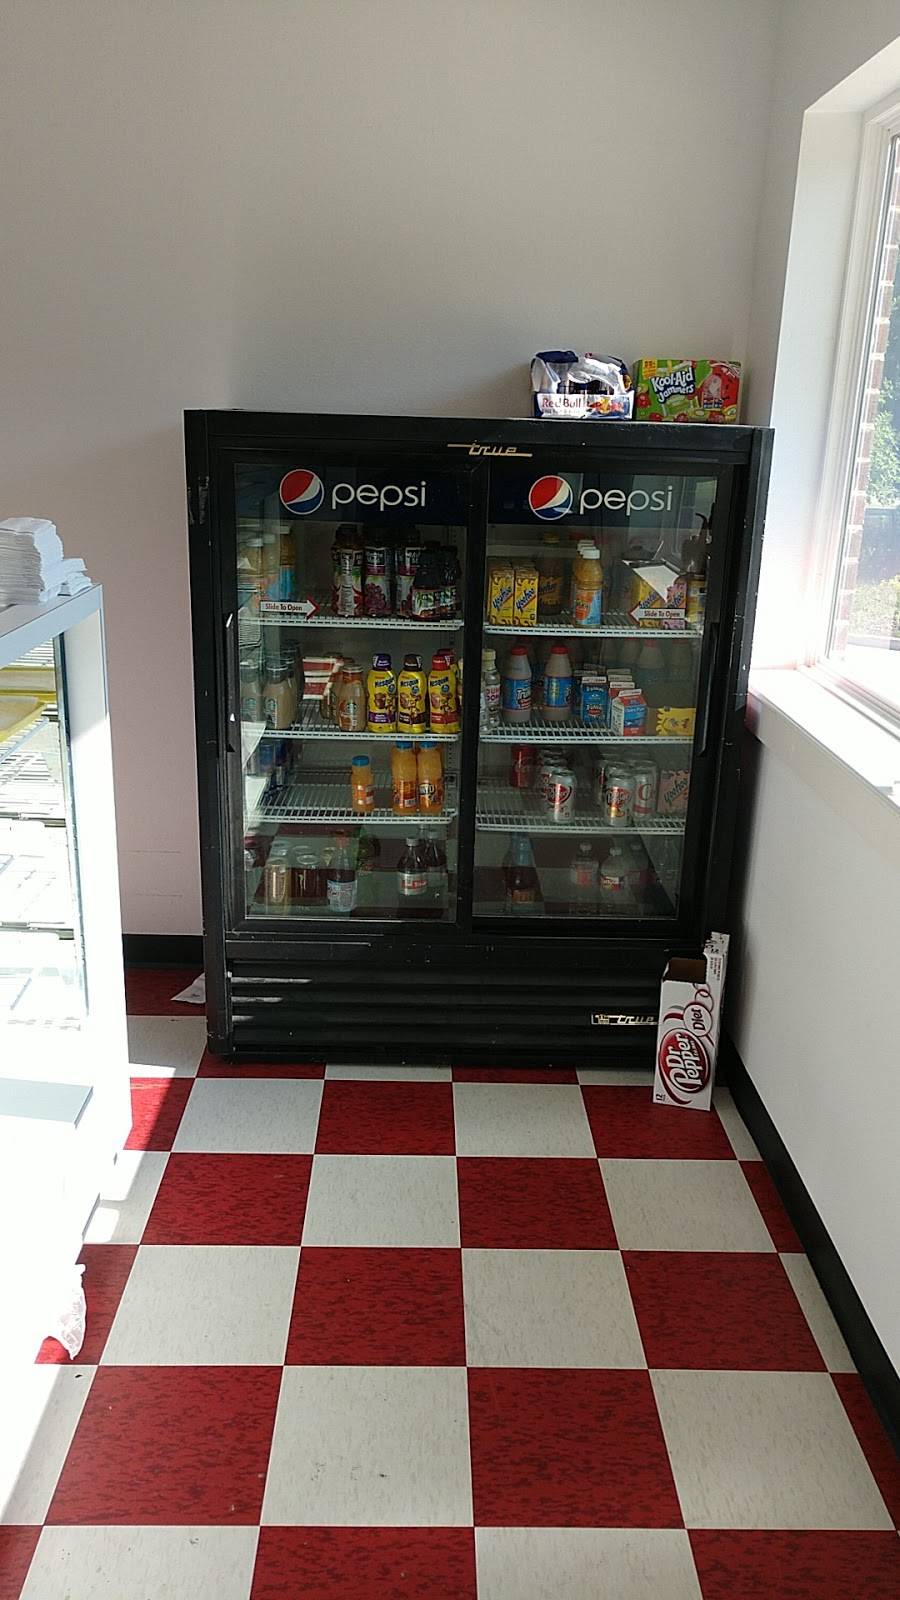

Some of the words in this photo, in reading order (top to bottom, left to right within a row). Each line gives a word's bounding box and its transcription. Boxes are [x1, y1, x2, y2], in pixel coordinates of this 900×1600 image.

[650, 367, 694, 392] Kool-Aid
[563, 398, 581, 408] Bull
[658, 384, 694, 403] Jammers
[331, 480, 426, 512] pepsi
[579, 485, 673, 516] pepsi
[665, 611, 680, 619] Open
[691, 1008, 706, 1031] Diet
[666, 1045, 684, 1069] Dr
[670, 1032, 704, 1092] Pepper
